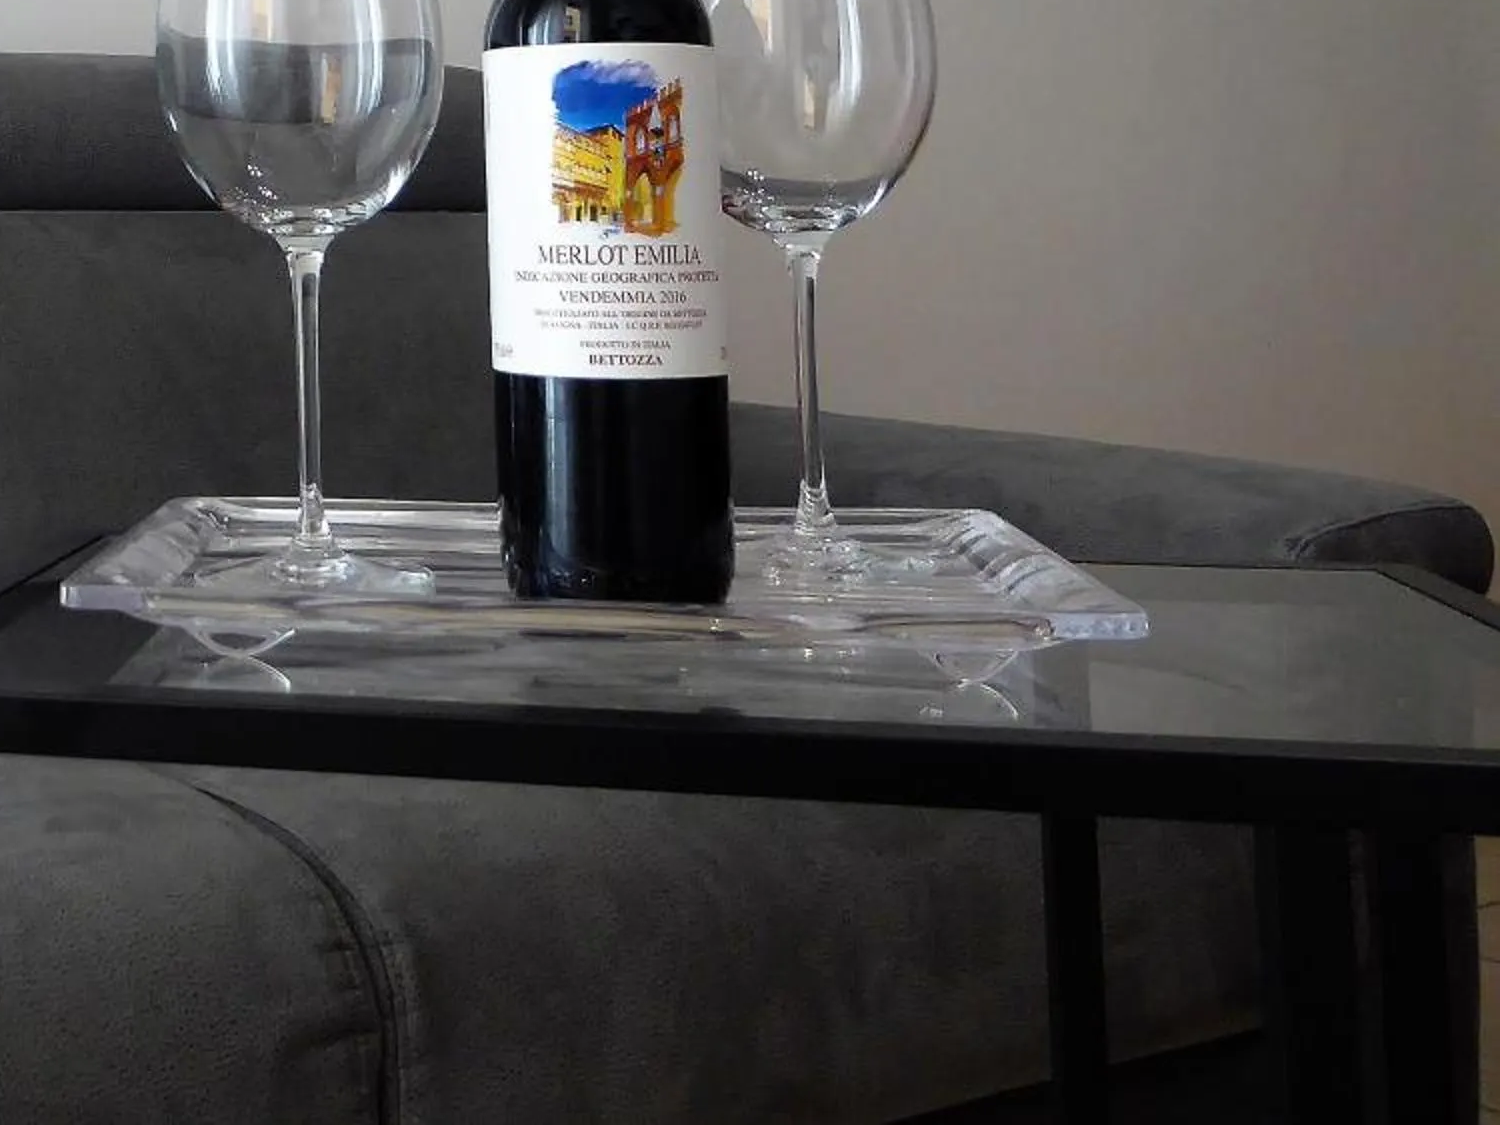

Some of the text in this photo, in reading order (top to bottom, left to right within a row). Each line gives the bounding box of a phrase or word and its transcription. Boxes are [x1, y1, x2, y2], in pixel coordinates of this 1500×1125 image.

[539, 244, 701, 265] MERLOT EMILIA
[590, 271, 676, 284] GEOGRAFICA
[559, 290, 687, 304] VENDEMMIA 2016
[589, 354, 663, 366] BETTOZZA
